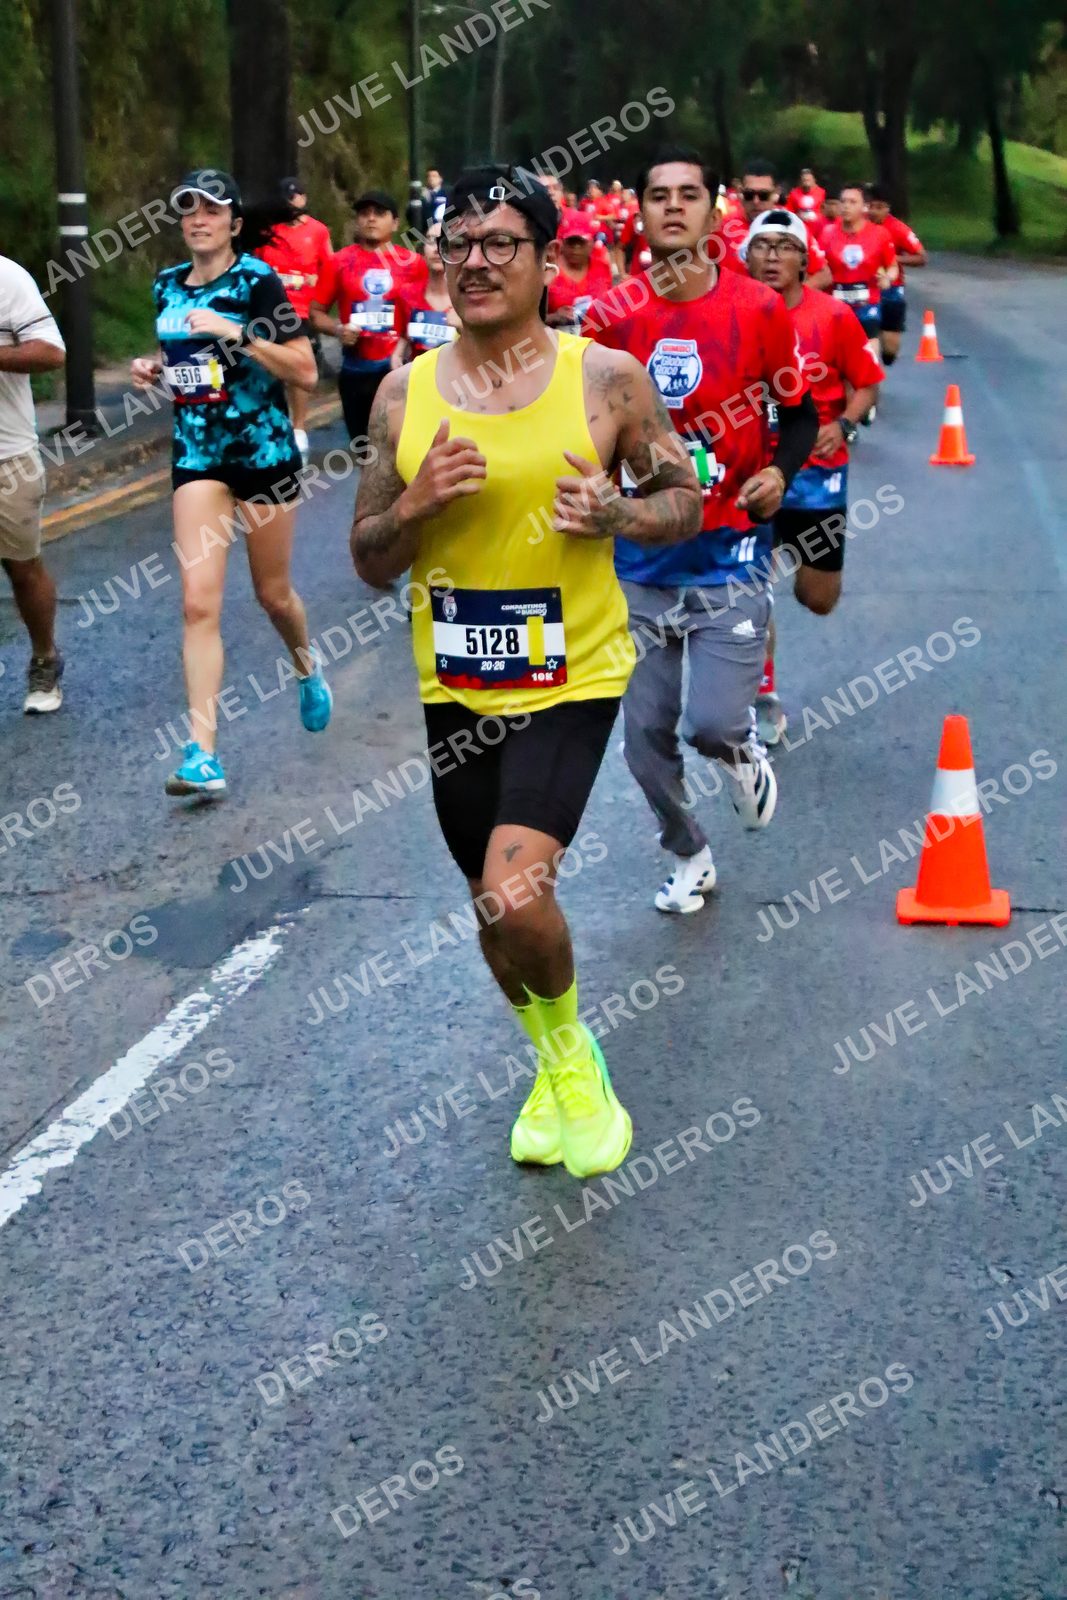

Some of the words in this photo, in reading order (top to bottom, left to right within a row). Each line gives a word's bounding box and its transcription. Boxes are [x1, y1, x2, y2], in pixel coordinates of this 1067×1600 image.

[174, 367, 202, 384] 5516
[466, 627, 520, 655] 5128
[532, 673, 553, 681] 10K
